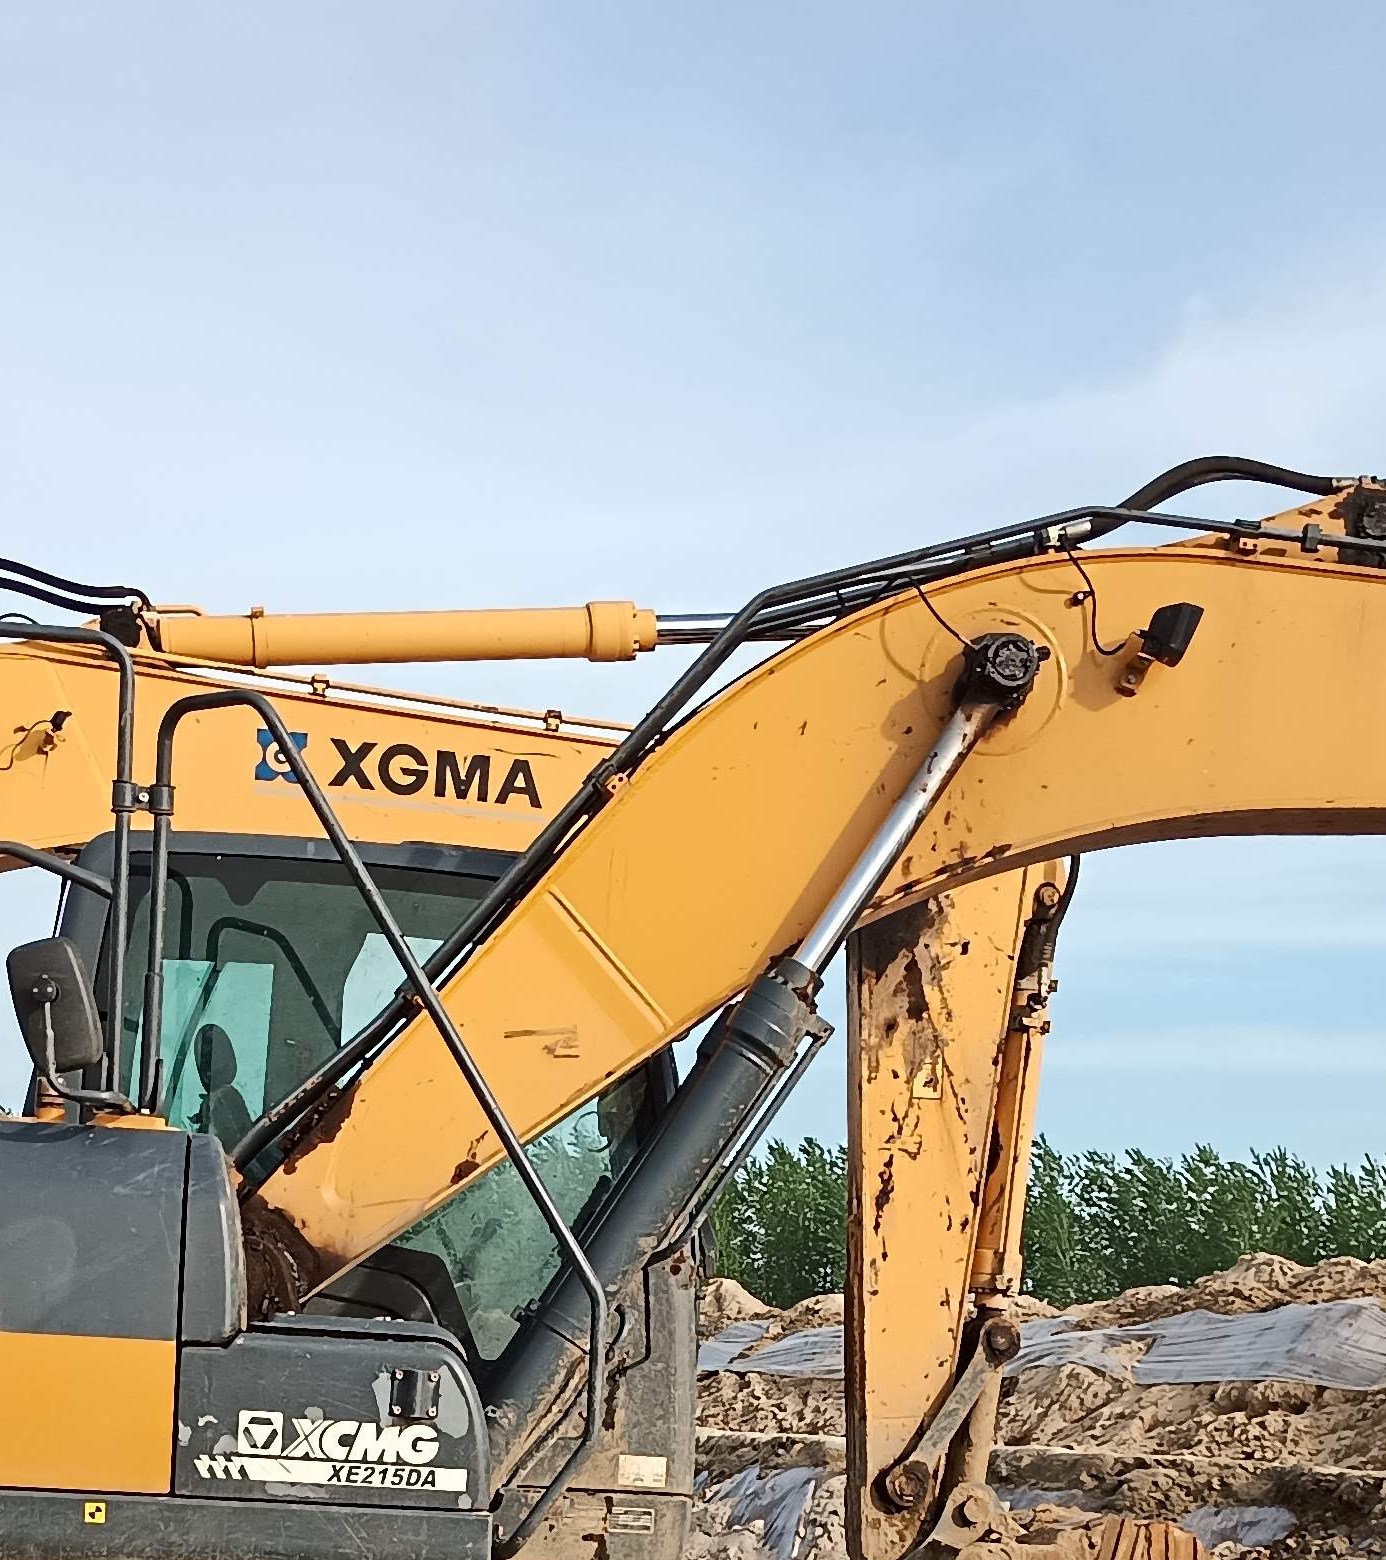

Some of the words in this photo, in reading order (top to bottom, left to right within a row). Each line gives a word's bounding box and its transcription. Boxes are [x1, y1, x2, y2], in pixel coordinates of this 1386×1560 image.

[328, 738, 542, 808] XGMA
[281, 1418, 439, 1464] XCMG
[327, 1464, 436, 1488] XE215DA
